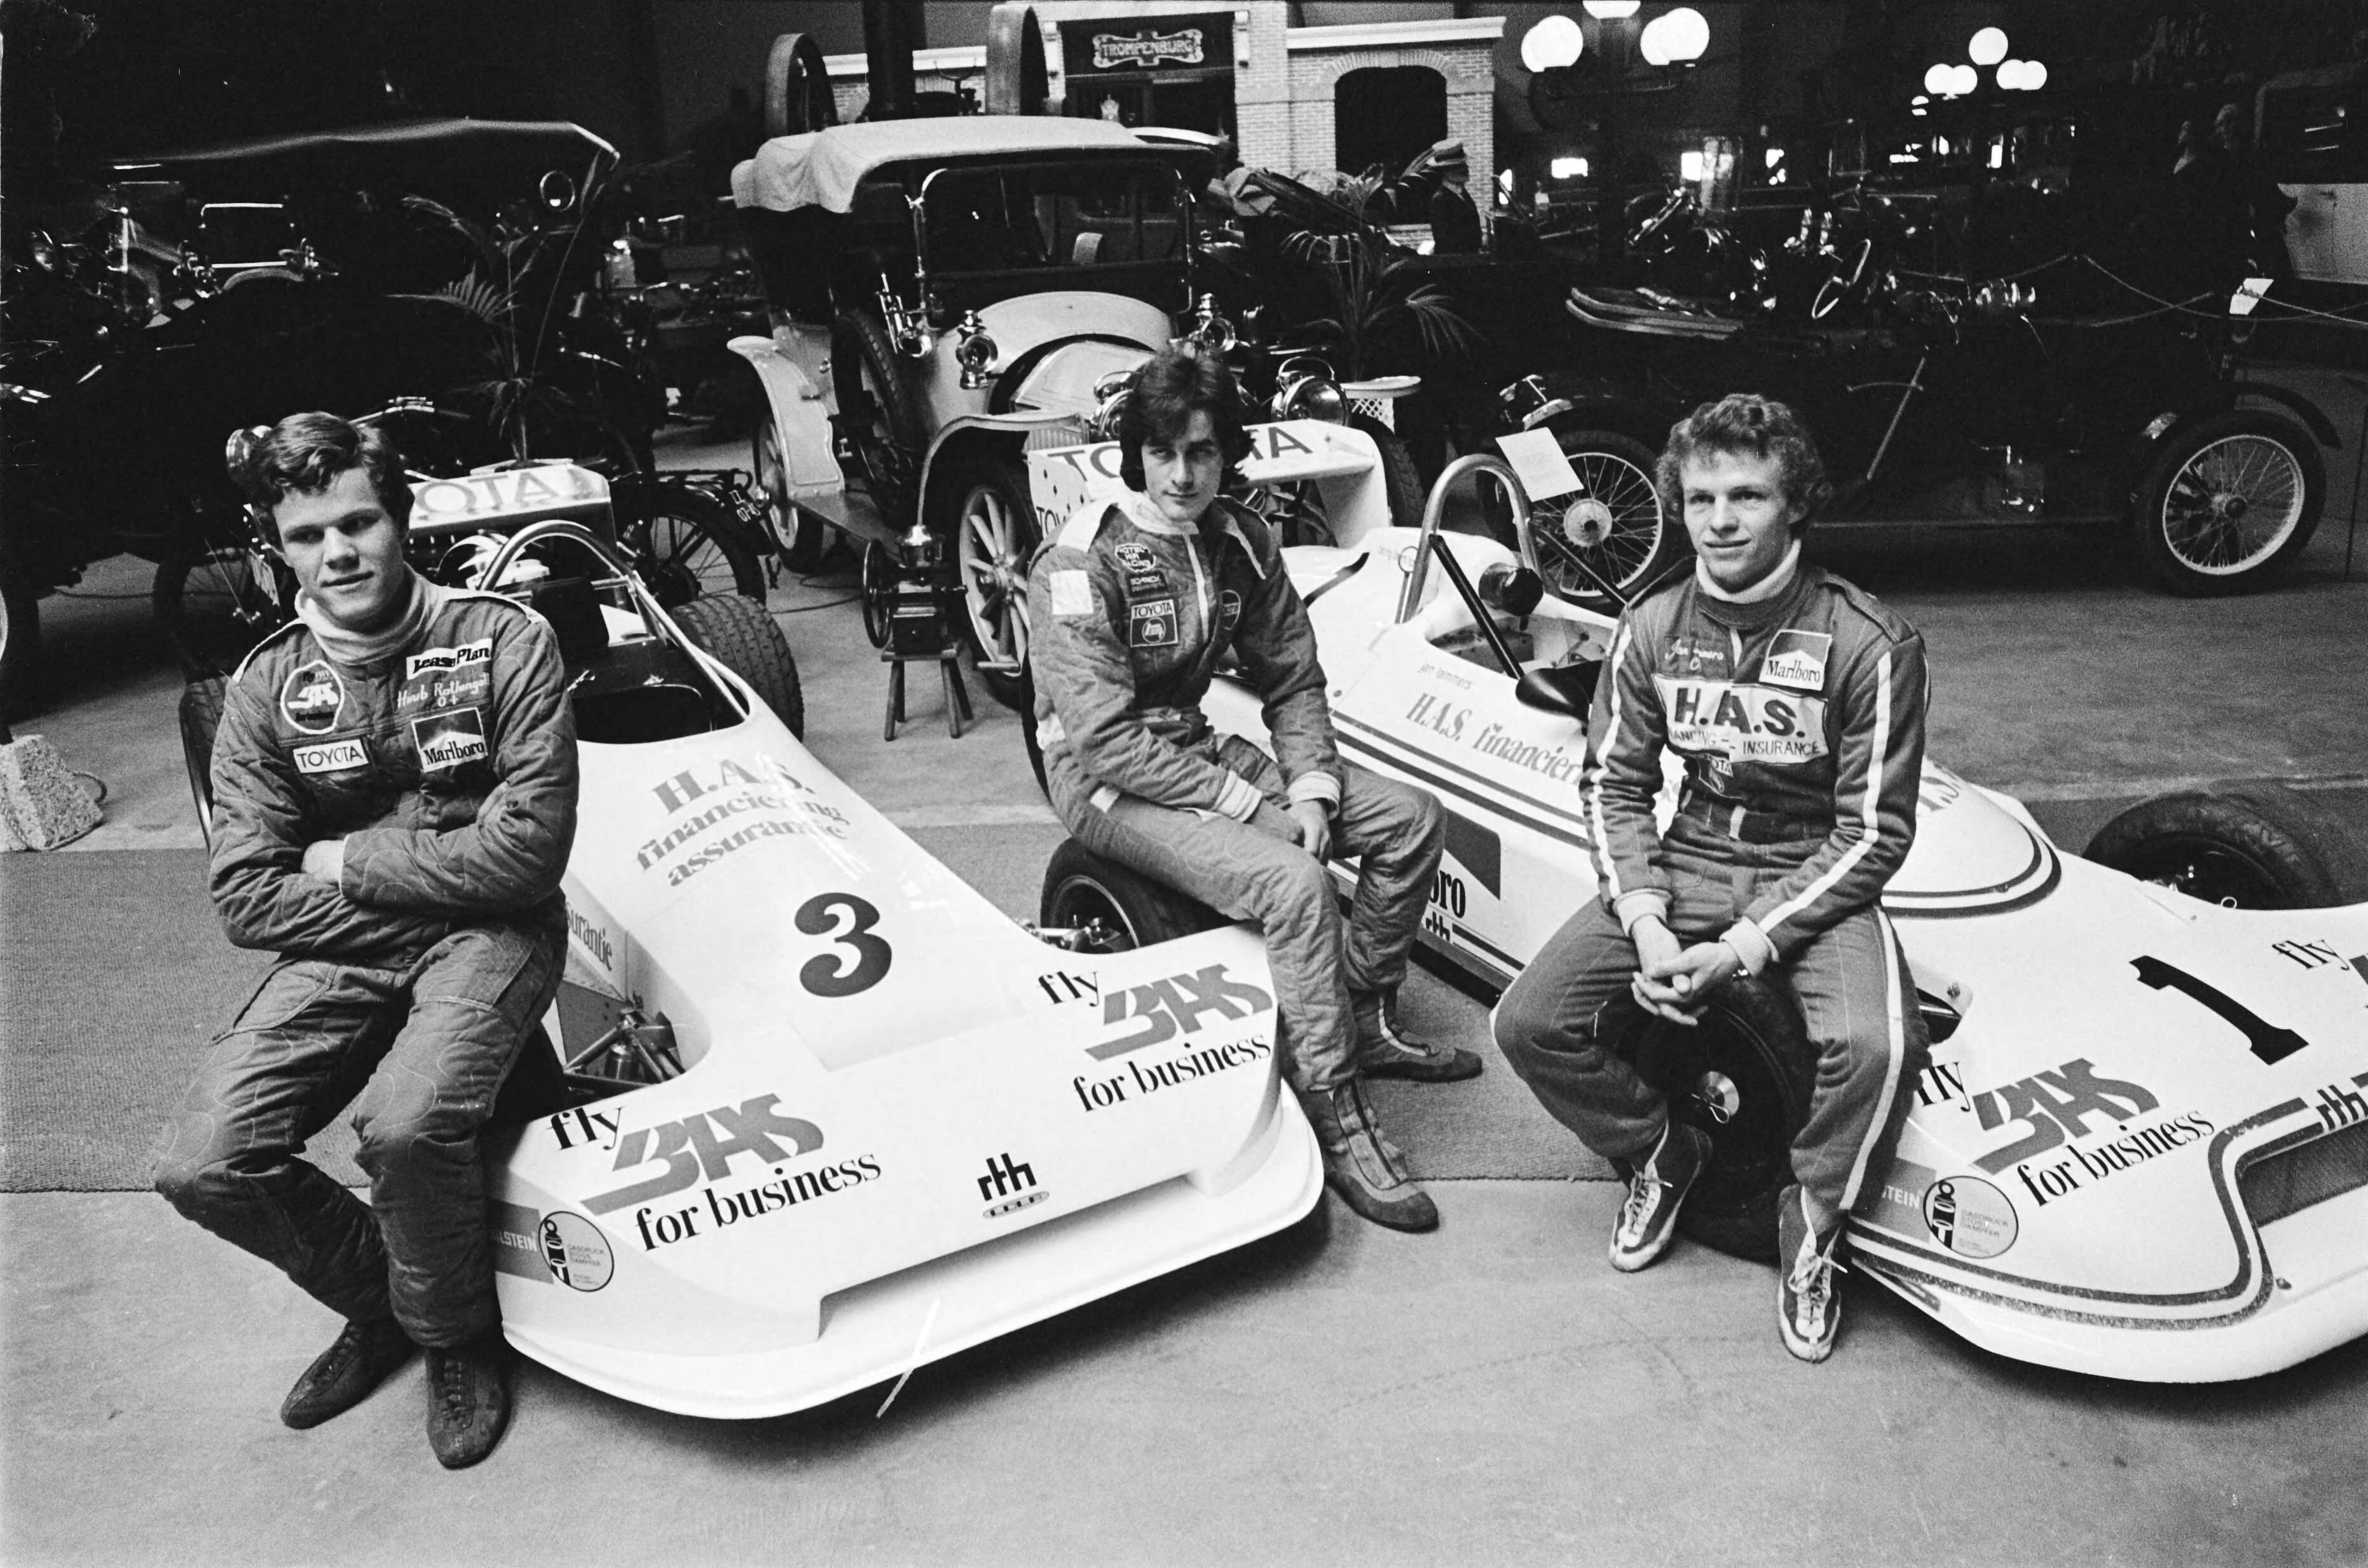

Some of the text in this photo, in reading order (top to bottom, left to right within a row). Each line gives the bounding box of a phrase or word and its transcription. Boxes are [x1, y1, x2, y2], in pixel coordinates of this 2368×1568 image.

[1133, 602, 1173, 618] TOYOTA
[1765, 660, 1821, 683] Marlboro
[1674, 687, 1806, 737] H.A.S.
[296, 746, 364, 768] TOYOTA
[423, 740, 485, 765] Marlboro
[1742, 739, 1821, 756] INSURANCE
[794, 892, 893, 998] 3
[2271, 939, 2350, 971] fly
[1037, 971, 1099, 1007] fly
[1072, 1034, 1271, 1112] for business
[547, 1107, 625, 1151] fly
[2016, 1110, 2215, 1207] for business
[634, 1153, 882, 1251] for business
